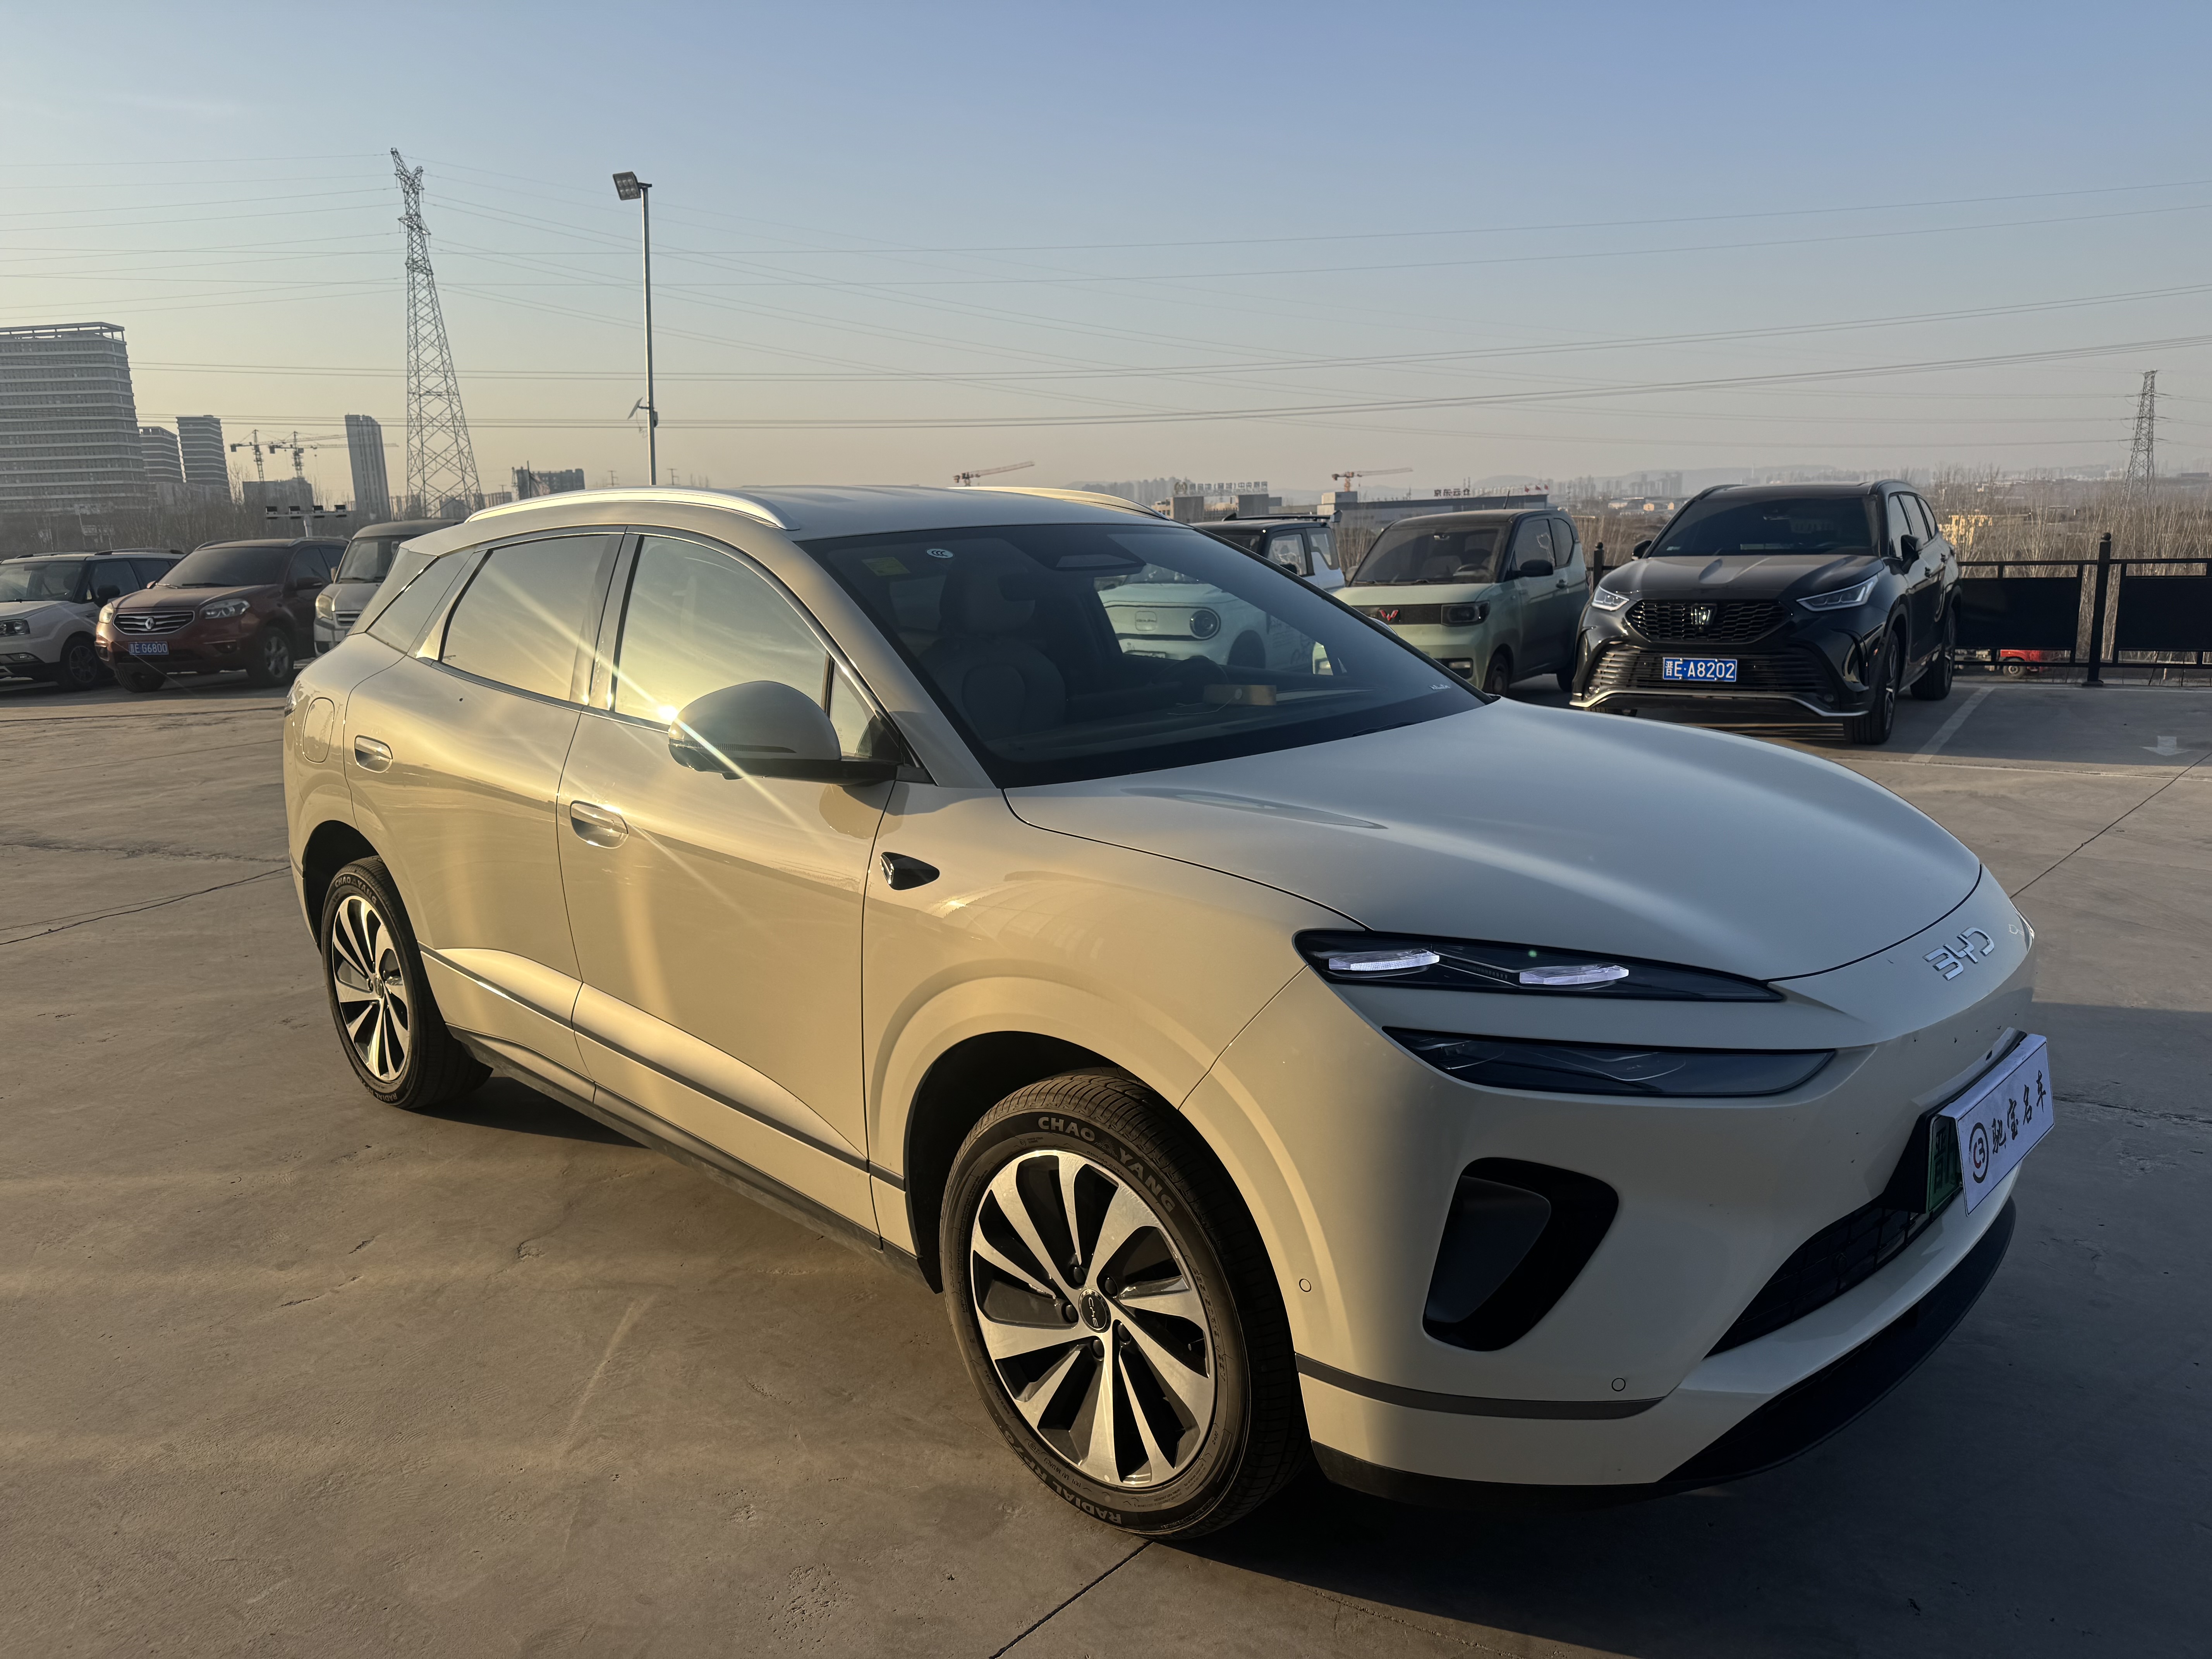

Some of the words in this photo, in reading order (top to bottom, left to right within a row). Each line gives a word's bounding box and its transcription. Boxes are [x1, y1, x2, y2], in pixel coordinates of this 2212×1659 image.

[1665, 661, 1735, 678] 晋E·A8202
[335, 876, 351, 888] CHAO
[357, 880, 377, 904] YANG
[1922, 927, 1995, 981] BYD
[1038, 1117, 1095, 1142] CHAO
[1120, 1147, 1176, 1212] YANG
[1053, 1480, 1122, 1525] RADIAL
